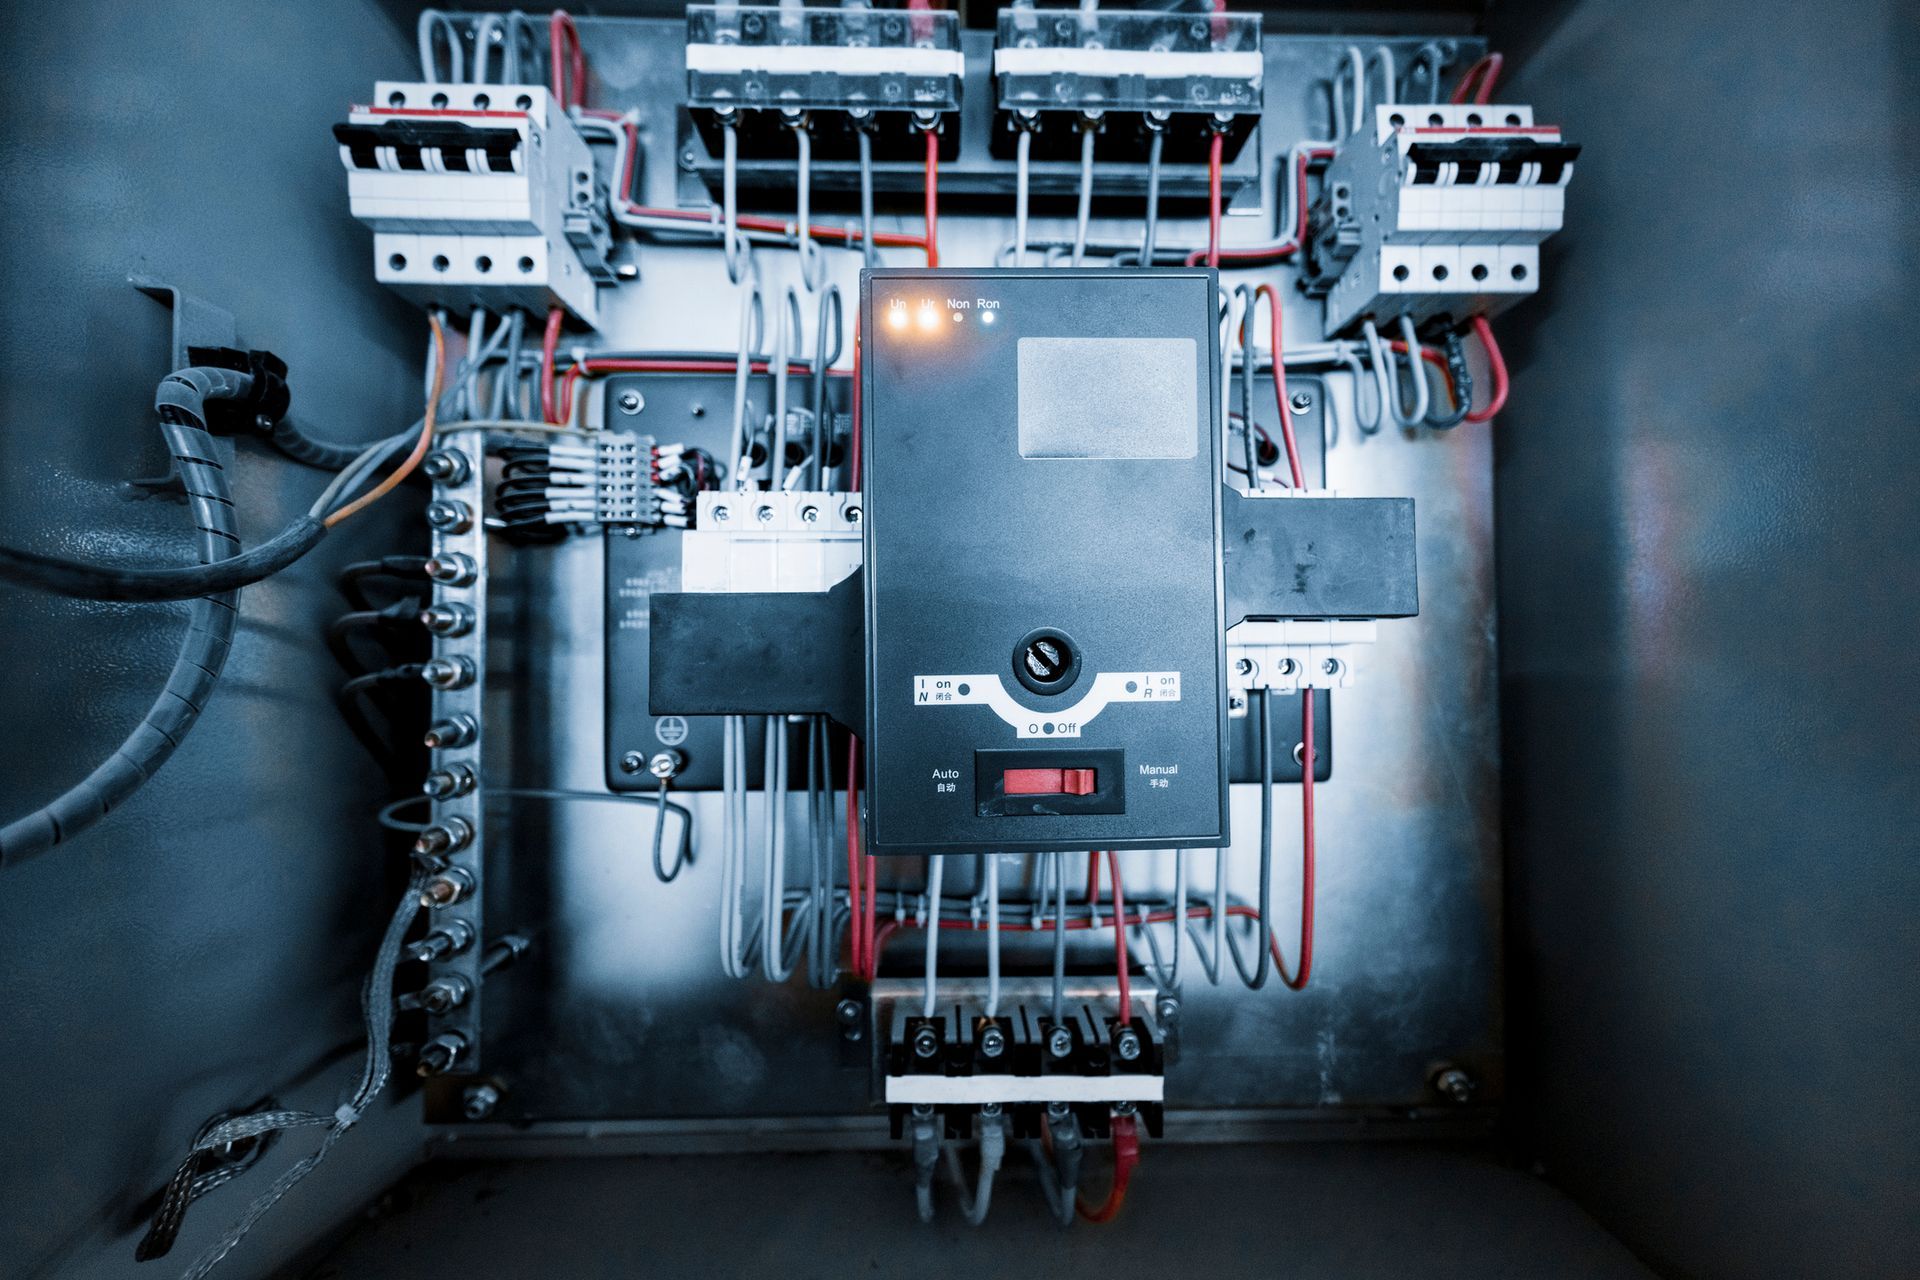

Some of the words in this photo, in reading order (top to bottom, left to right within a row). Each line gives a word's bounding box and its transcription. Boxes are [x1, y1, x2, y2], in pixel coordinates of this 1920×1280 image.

[947, 299, 970, 309] Non
[977, 299, 1000, 309] Ron
[936, 680, 951, 689] on
[1160, 677, 1175, 685] on
[918, 692, 929, 702] N
[935, 692, 953, 701] 闭合
[1143, 688, 1153, 698] R
[1057, 723, 1077, 734] Off
[932, 769, 960, 779] Auto
[1139, 764, 1178, 775] Manual
[937, 783, 956, 793] 自动
[1149, 779, 1169, 789] 手动
